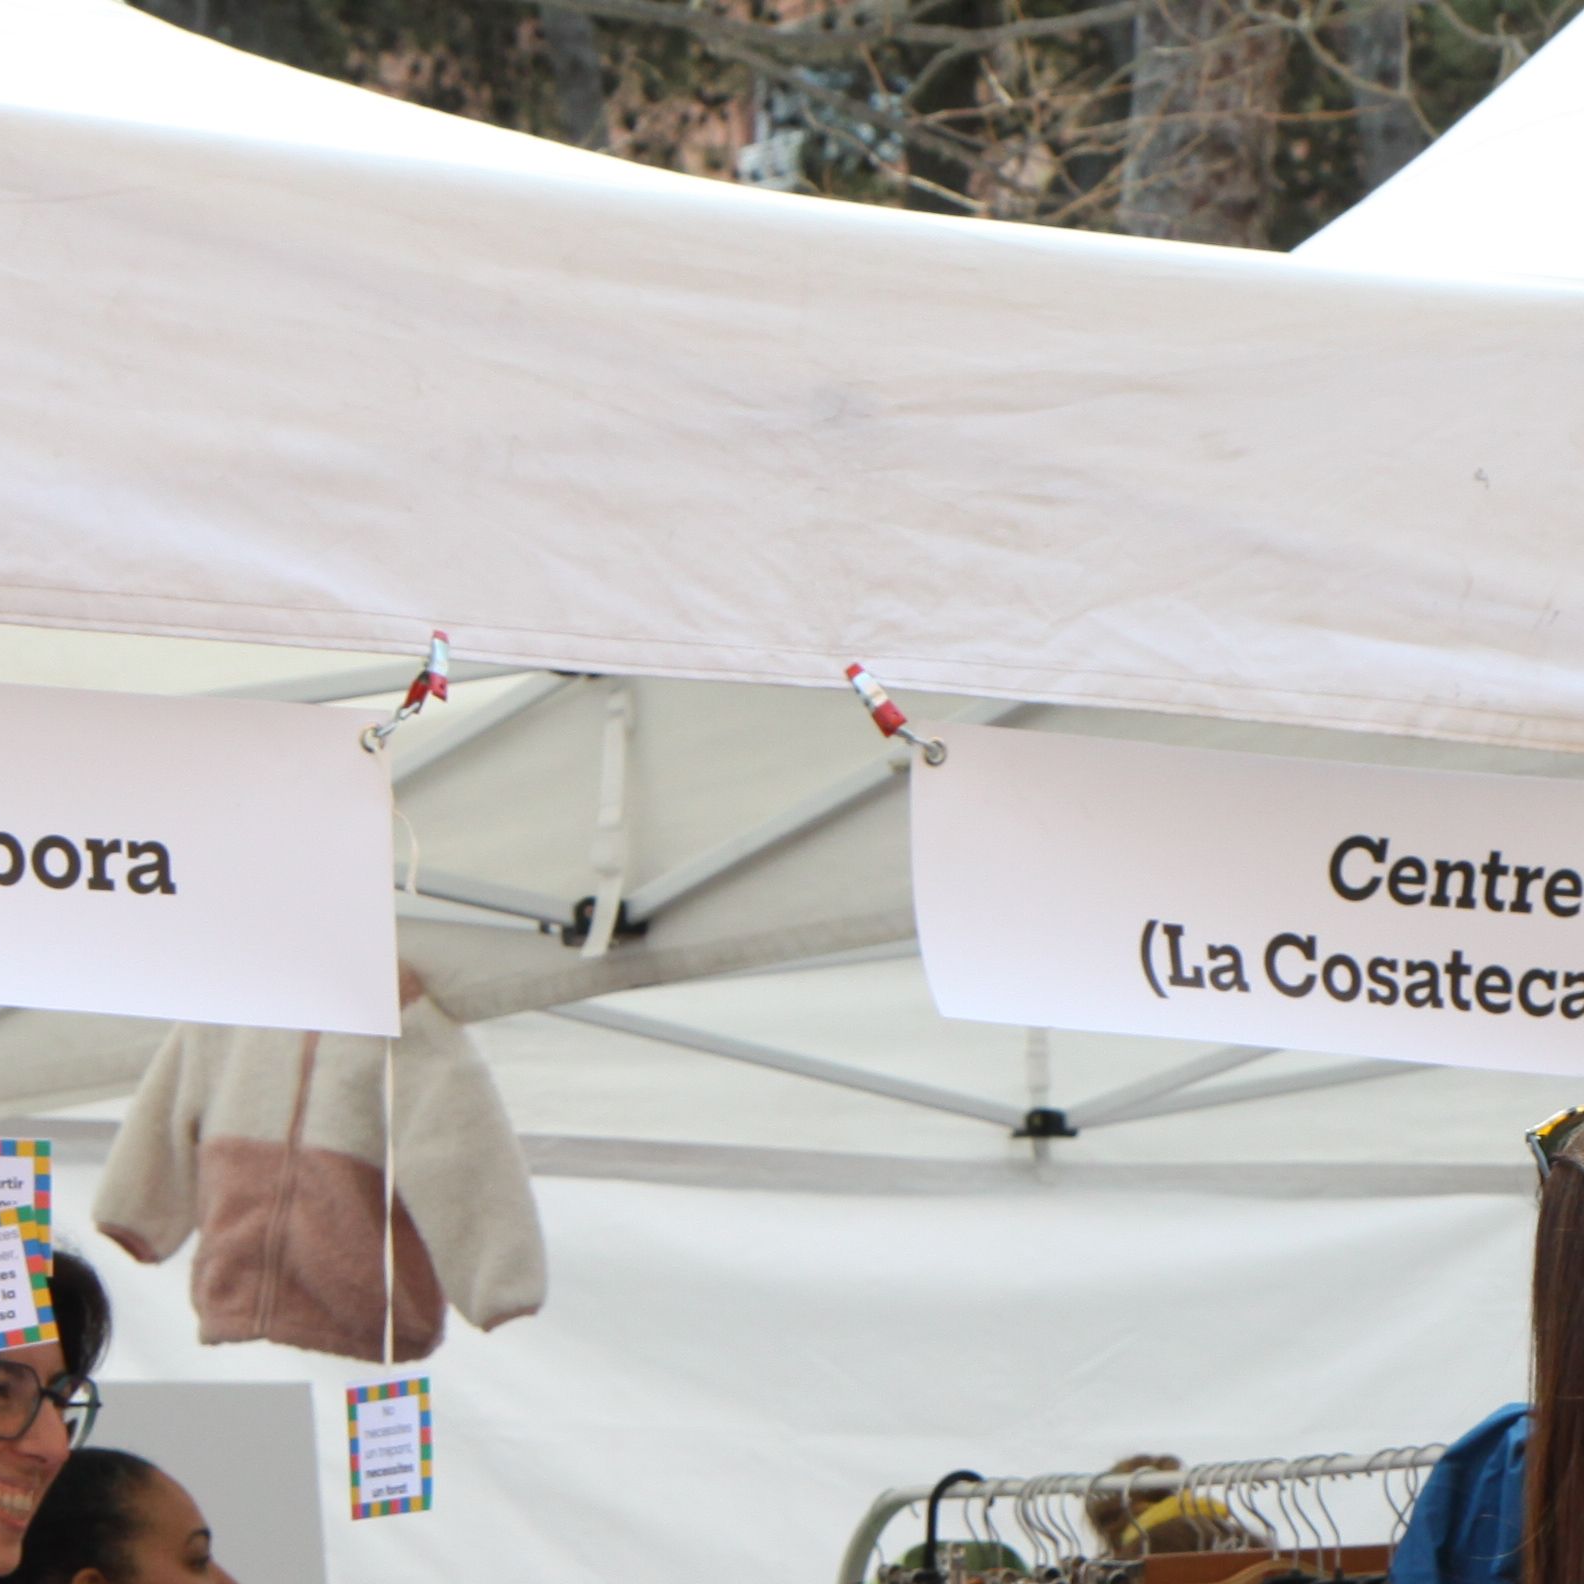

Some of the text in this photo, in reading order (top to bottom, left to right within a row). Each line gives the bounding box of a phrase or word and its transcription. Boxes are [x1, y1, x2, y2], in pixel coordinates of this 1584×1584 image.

[1329, 834, 1584, 918] Centre
[1140, 919, 1251, 998] (La
[1, 1288, 16, 1301] la
